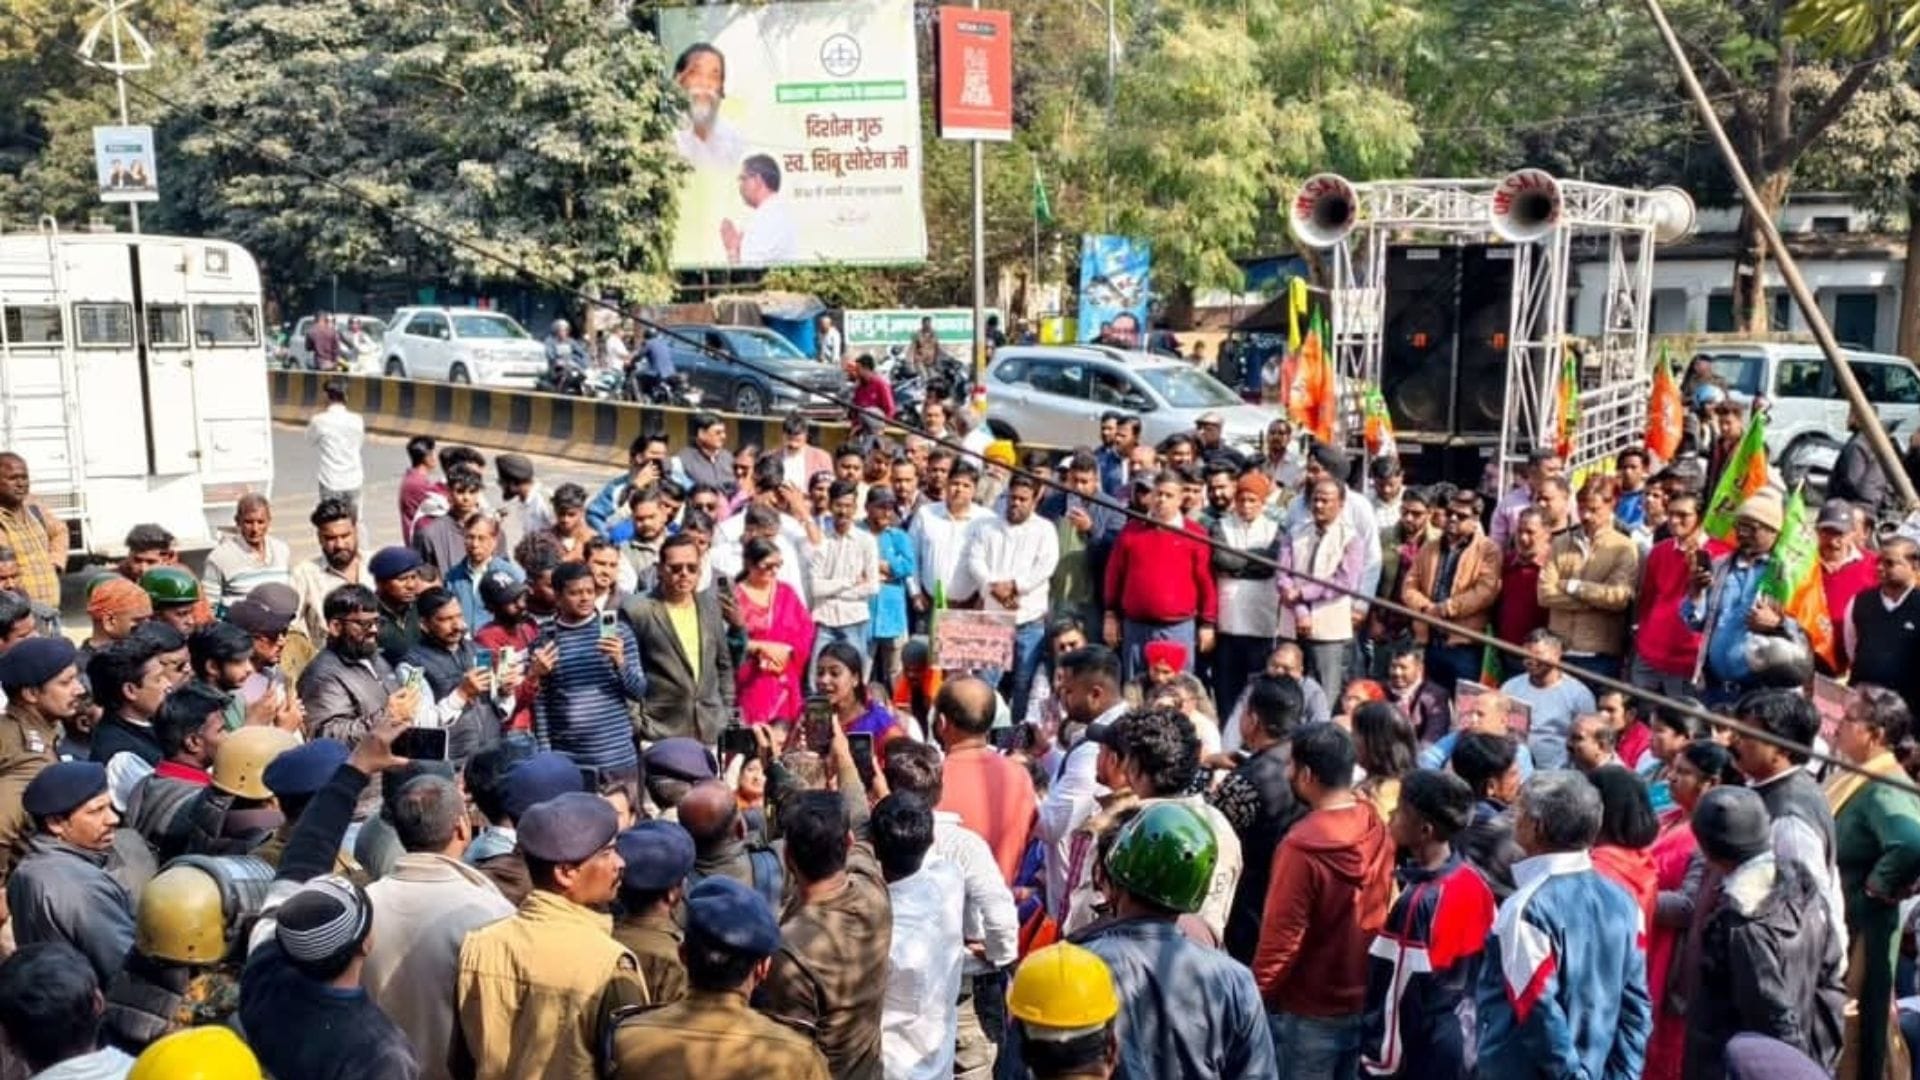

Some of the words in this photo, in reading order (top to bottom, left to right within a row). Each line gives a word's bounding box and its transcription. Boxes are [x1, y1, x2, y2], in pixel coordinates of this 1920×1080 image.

[805, 113, 854, 138] दिशोम
[856, 117, 884, 142] गुरु
[783, 153, 808, 172] स्व.
[811, 148, 846, 177] शिबू
[845, 146, 887, 171] सोरेन
[890, 144, 908, 169] जी
